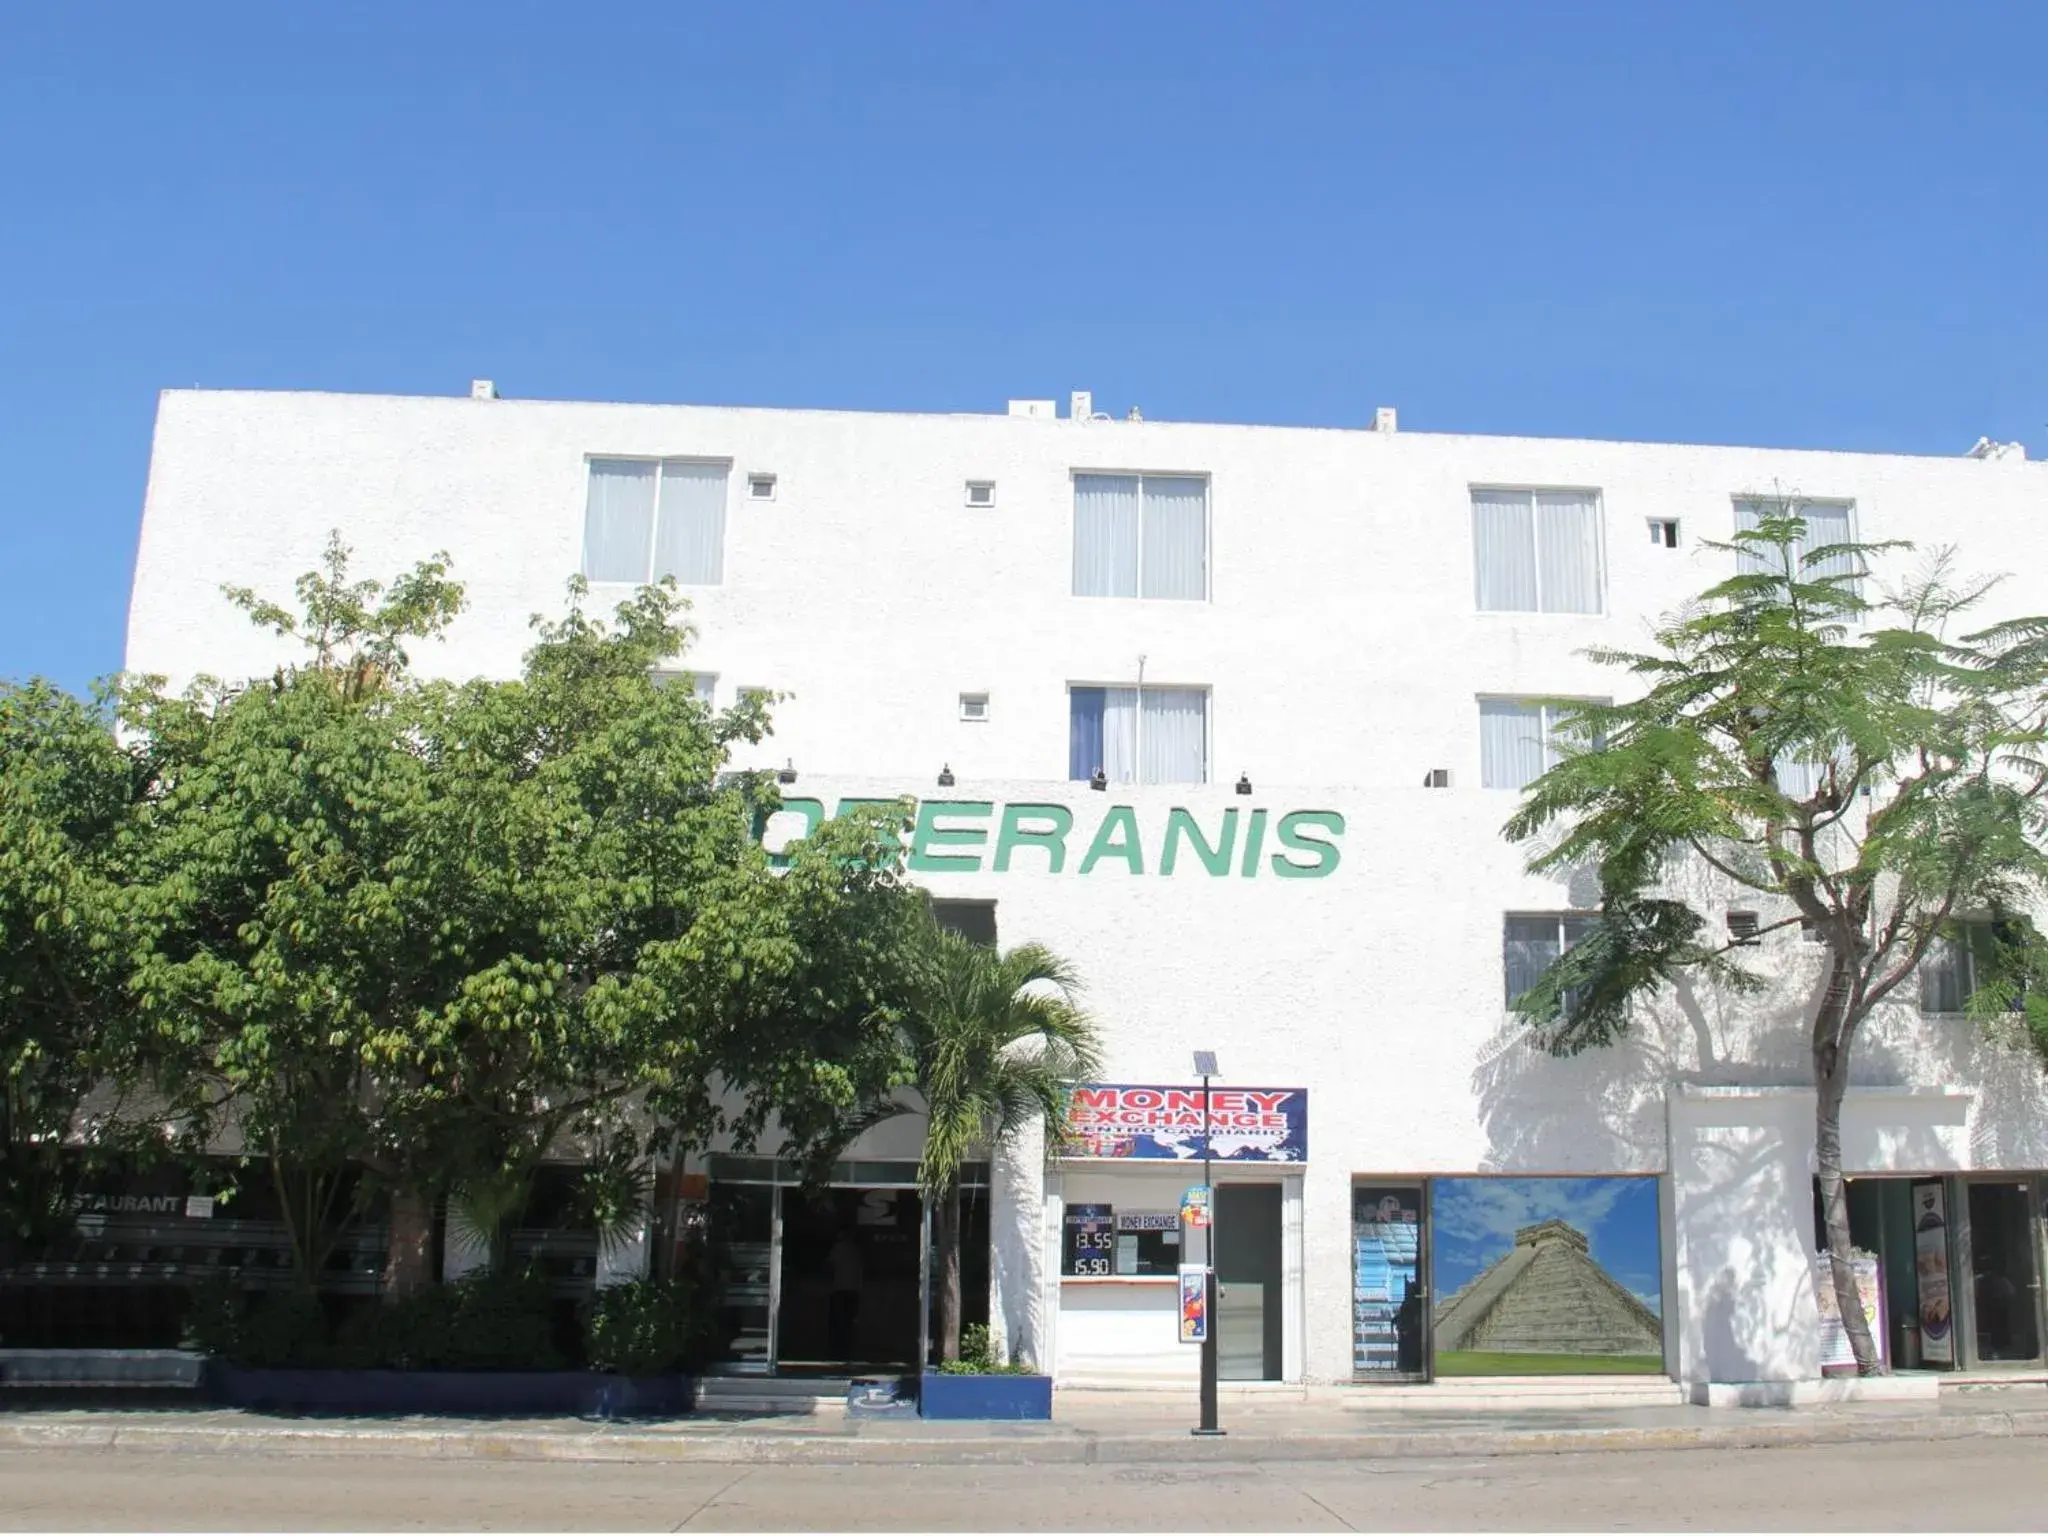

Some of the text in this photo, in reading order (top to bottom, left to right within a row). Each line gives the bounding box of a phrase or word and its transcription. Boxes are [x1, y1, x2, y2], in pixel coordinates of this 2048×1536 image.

[1073, 1088, 1293, 1112] MONEY
[1068, 1110, 1287, 1128] EXCHANGE
[1120, 1215, 1142, 1229] MONEY
[1144, 1215, 1176, 1229] EXCHANGE
[1076, 1232, 1112, 1249] 13.55
[1075, 1258, 1109, 1275] 15.90
